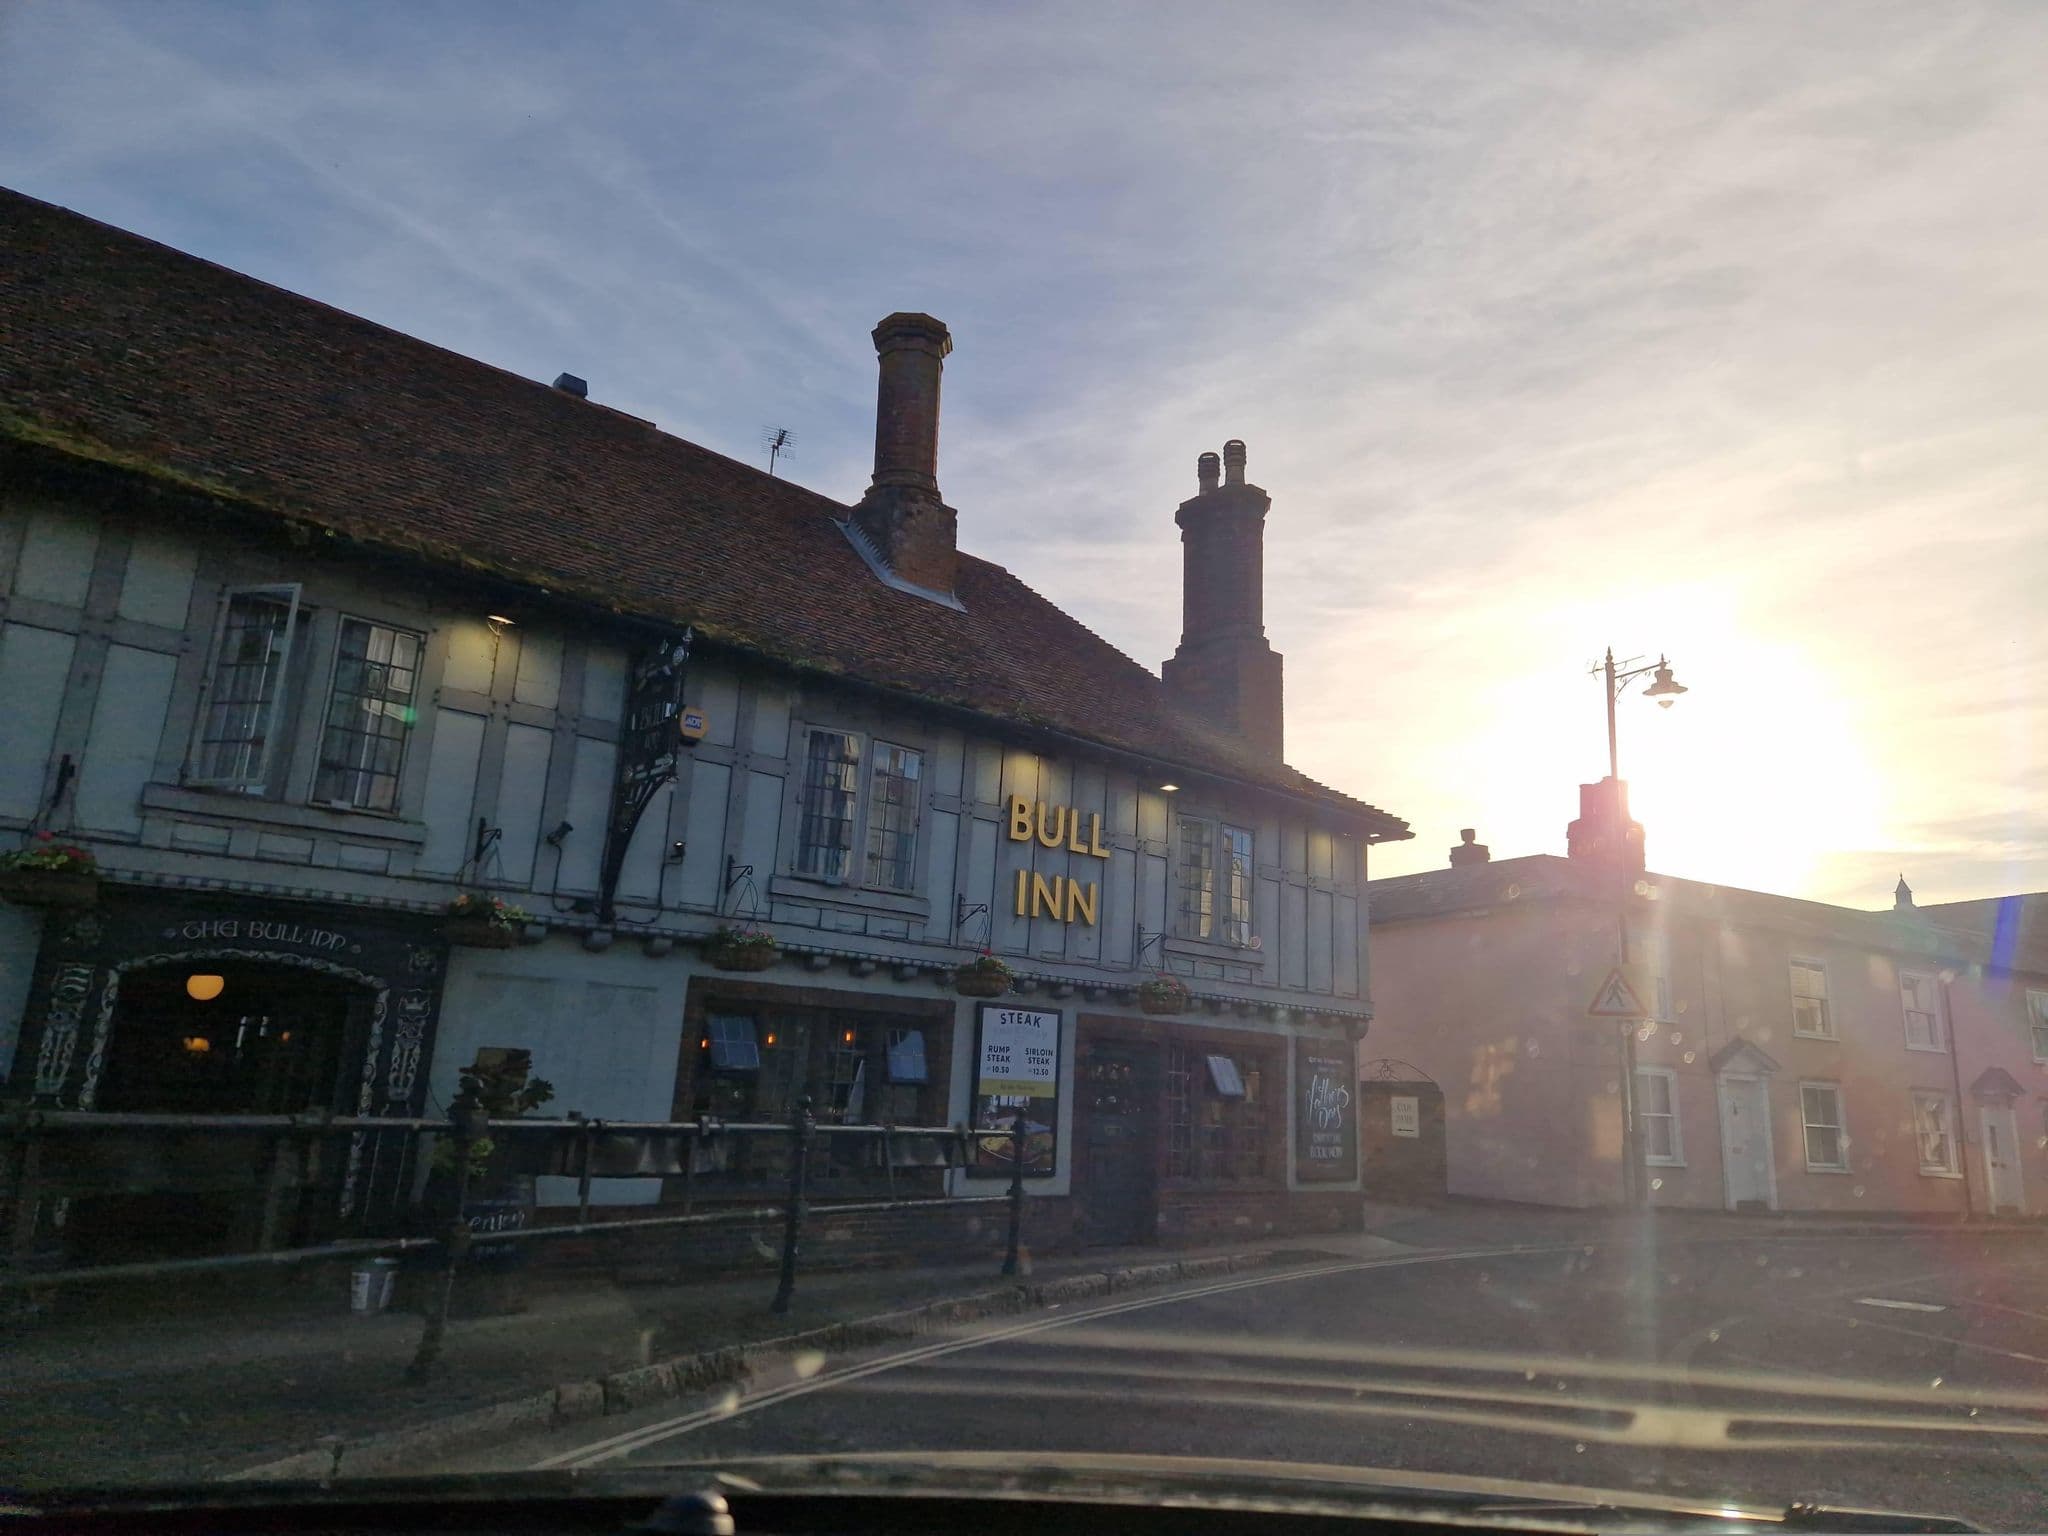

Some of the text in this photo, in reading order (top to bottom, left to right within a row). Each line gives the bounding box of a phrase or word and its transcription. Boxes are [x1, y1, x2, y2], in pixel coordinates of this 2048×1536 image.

[1008, 794, 1111, 858] BULL
[1016, 869, 1097, 926] INN
[183, 920, 239, 939] THE
[250, 921, 304, 943] BULL
[1000, 1012, 1042, 1028] STEAK
[988, 1045, 1010, 1054] RUMP
[1025, 1047, 1053, 1056] SIRLOIN
[987, 1054, 1010, 1063] STEAK
[1028, 1056, 1050, 1065] STEAK
